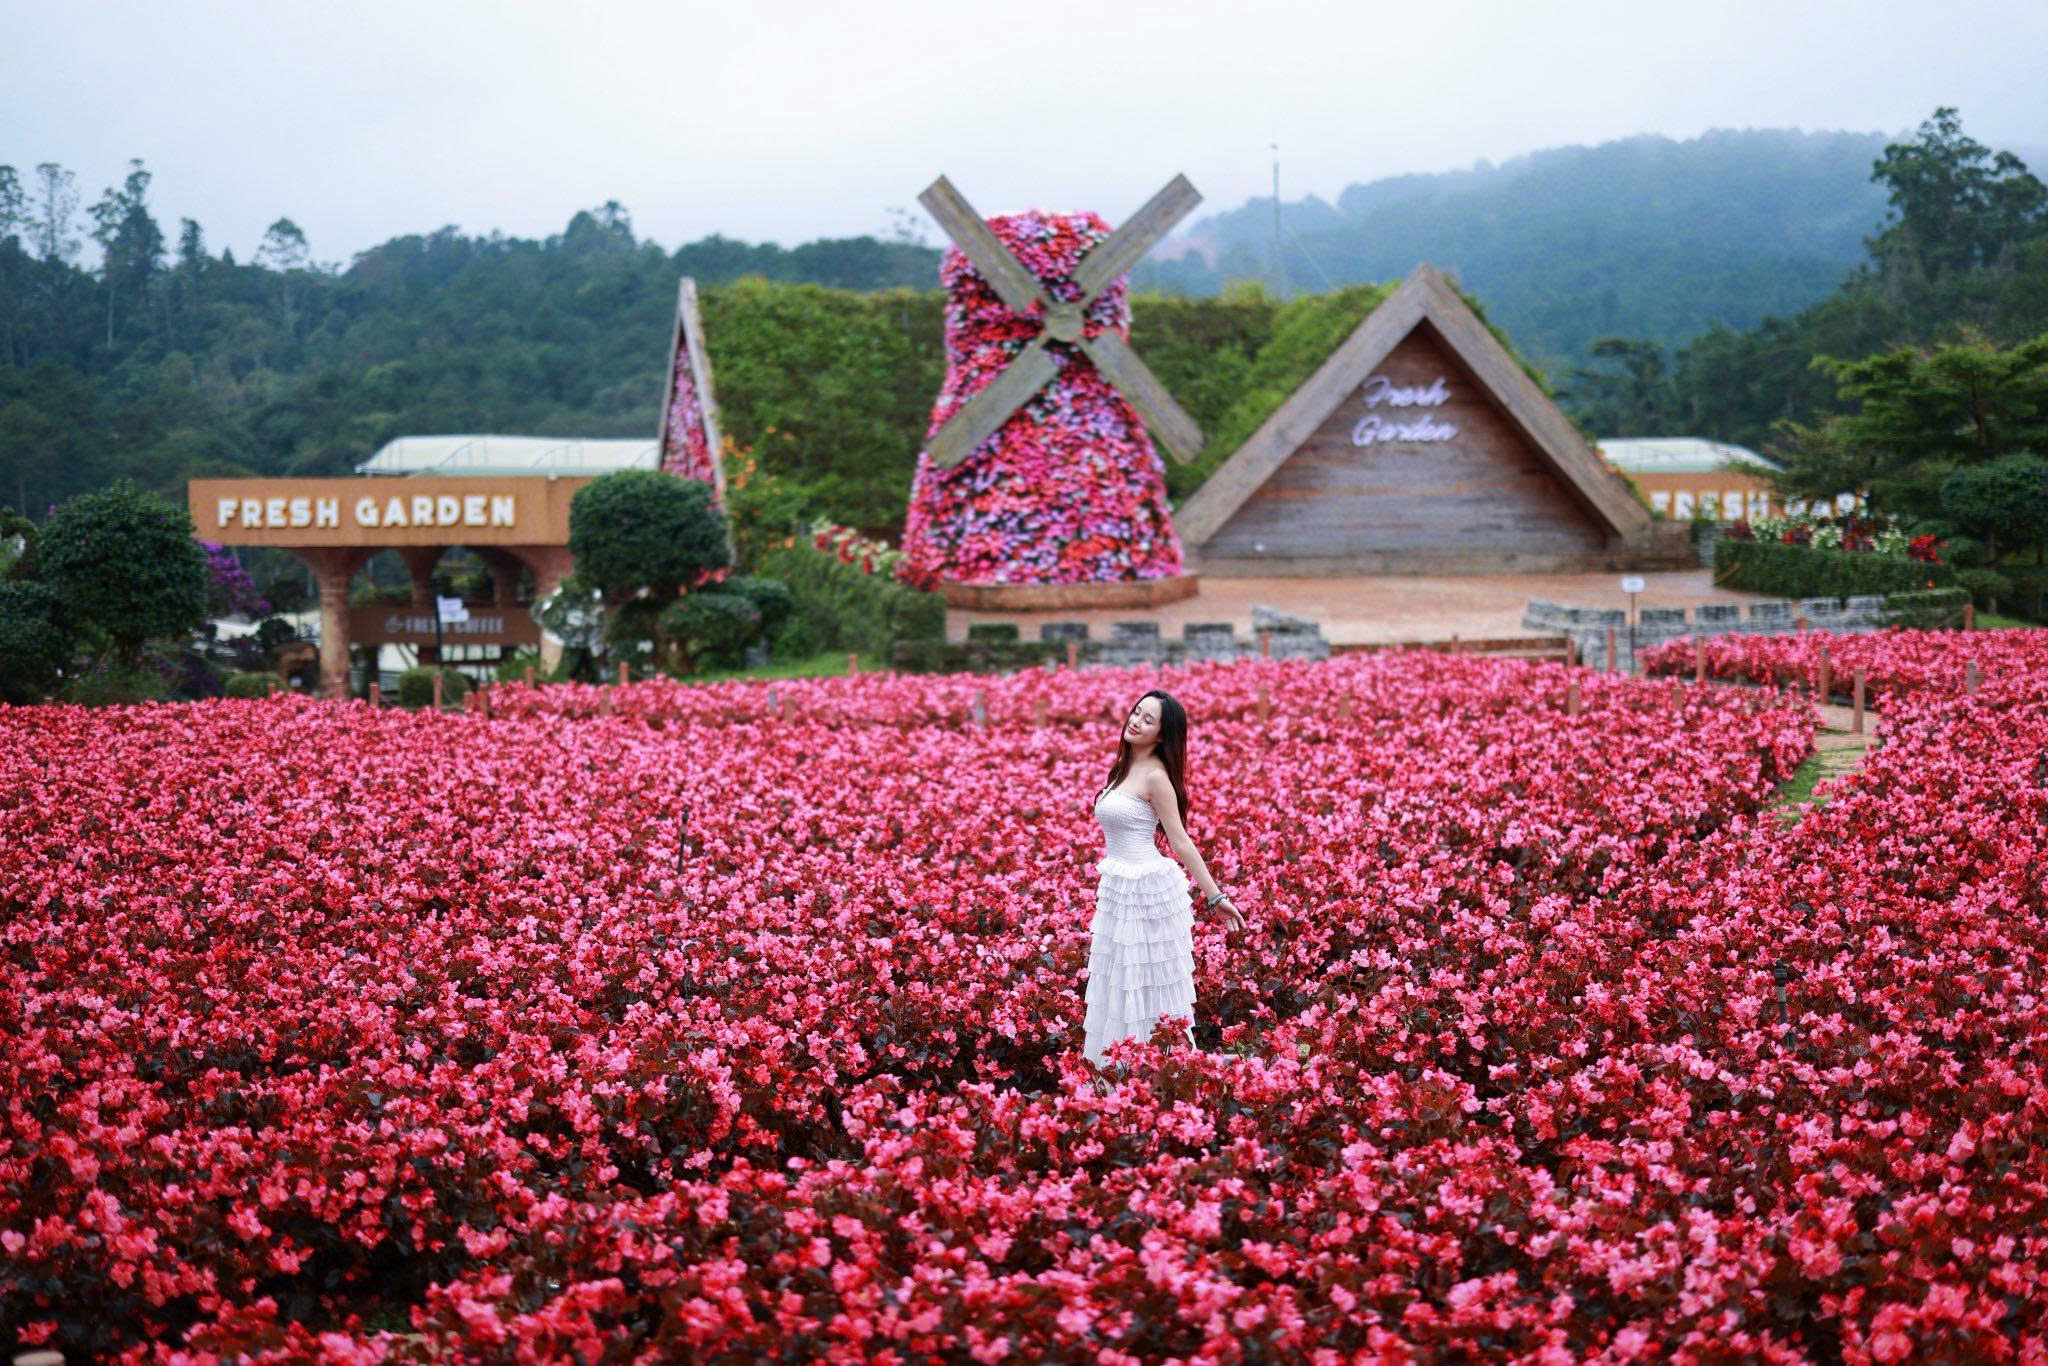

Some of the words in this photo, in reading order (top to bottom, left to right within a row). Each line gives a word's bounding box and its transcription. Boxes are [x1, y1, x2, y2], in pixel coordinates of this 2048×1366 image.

[1363, 375, 1452, 408] Fresh
[1352, 414, 1459, 447] Garden
[217, 498, 340, 528] FRESH
[355, 495, 515, 527] GARDEN
